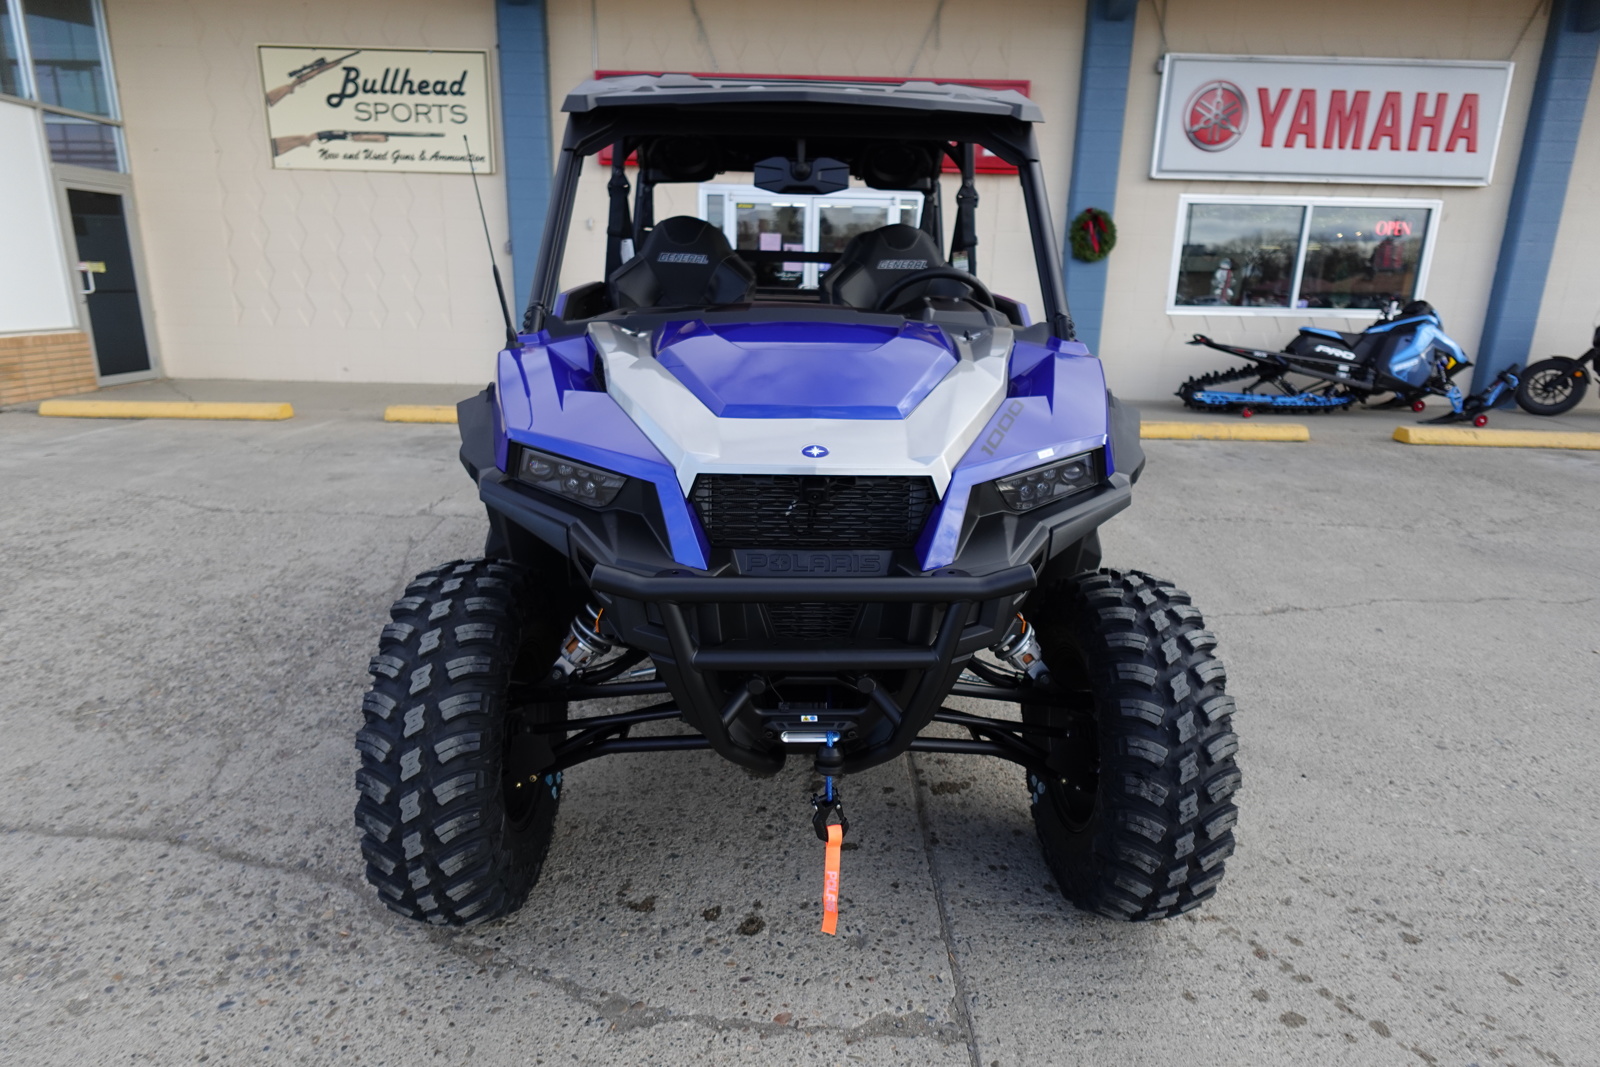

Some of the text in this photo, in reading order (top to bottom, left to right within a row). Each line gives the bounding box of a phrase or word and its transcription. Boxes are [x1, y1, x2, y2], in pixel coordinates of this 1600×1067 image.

[326, 66, 468, 108] Bullhead
[354, 101, 468, 125] SPORTS
[1257, 88, 1479, 153] YAMAHA
[318, 148, 486, 164] New and Used Guns & Ammunition
[1375, 220, 1412, 236] OPEN
[657, 252, 709, 264] GENERAL
[877, 260, 928, 269] GENERAL
[1314, 344, 1357, 361] PRO
[981, 399, 1025, 457] 1000
[745, 553, 881, 573] POLARIS
